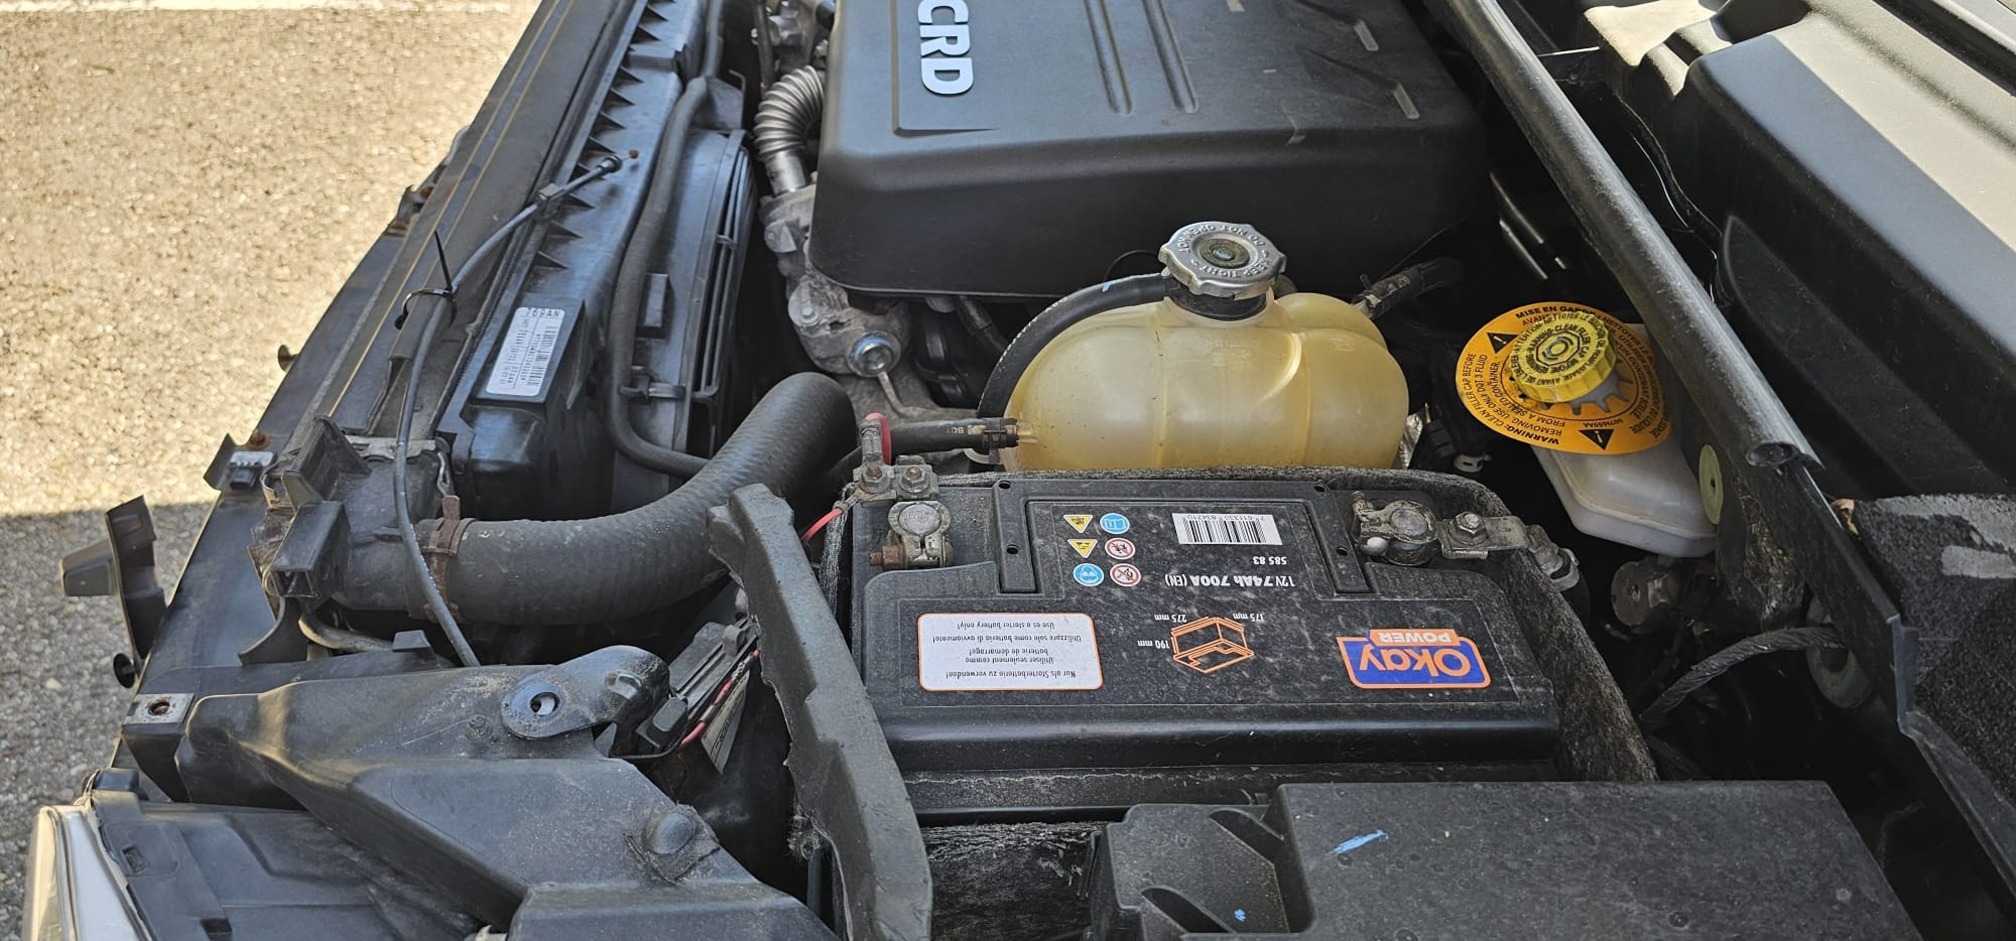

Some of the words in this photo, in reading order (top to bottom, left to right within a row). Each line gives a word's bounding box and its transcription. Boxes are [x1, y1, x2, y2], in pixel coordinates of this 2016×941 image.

[918, 0, 974, 95] CRD
[1515, 307, 1541, 319] MISE
[1462, 353, 1477, 377] BEFORE
[1475, 354, 1488, 373] FLUID
[1462, 378, 1473, 391] CAP
[1474, 380, 1486, 394] DOT
[1466, 391, 1483, 411] FILLER
[1480, 393, 1497, 412] ONLY
[1482, 409, 1504, 427] CLEAN
[1493, 407, 1510, 420] USE
[1536, 416, 1566, 428] FROM
[1505, 424, 1560, 445] WARNING:
[1252, 556, 1266, 565] 83
[1268, 556, 1287, 565] 585
[1164, 574, 1188, 587] (EN)
[1189, 575, 1231, 587] 700A
[1234, 575, 1274, 587] 74Ah
[1275, 575, 1296, 587] 12V
[1171, 614, 1187, 623] 275
[1249, 613, 1266, 622] 175
[1378, 632, 1452, 643] POWER
[1155, 640, 1170, 649] 190
[1359, 643, 1471, 677] Okay
[1051, 670, 1062, 678] als
[1064, 670, 1077, 678] Nur
